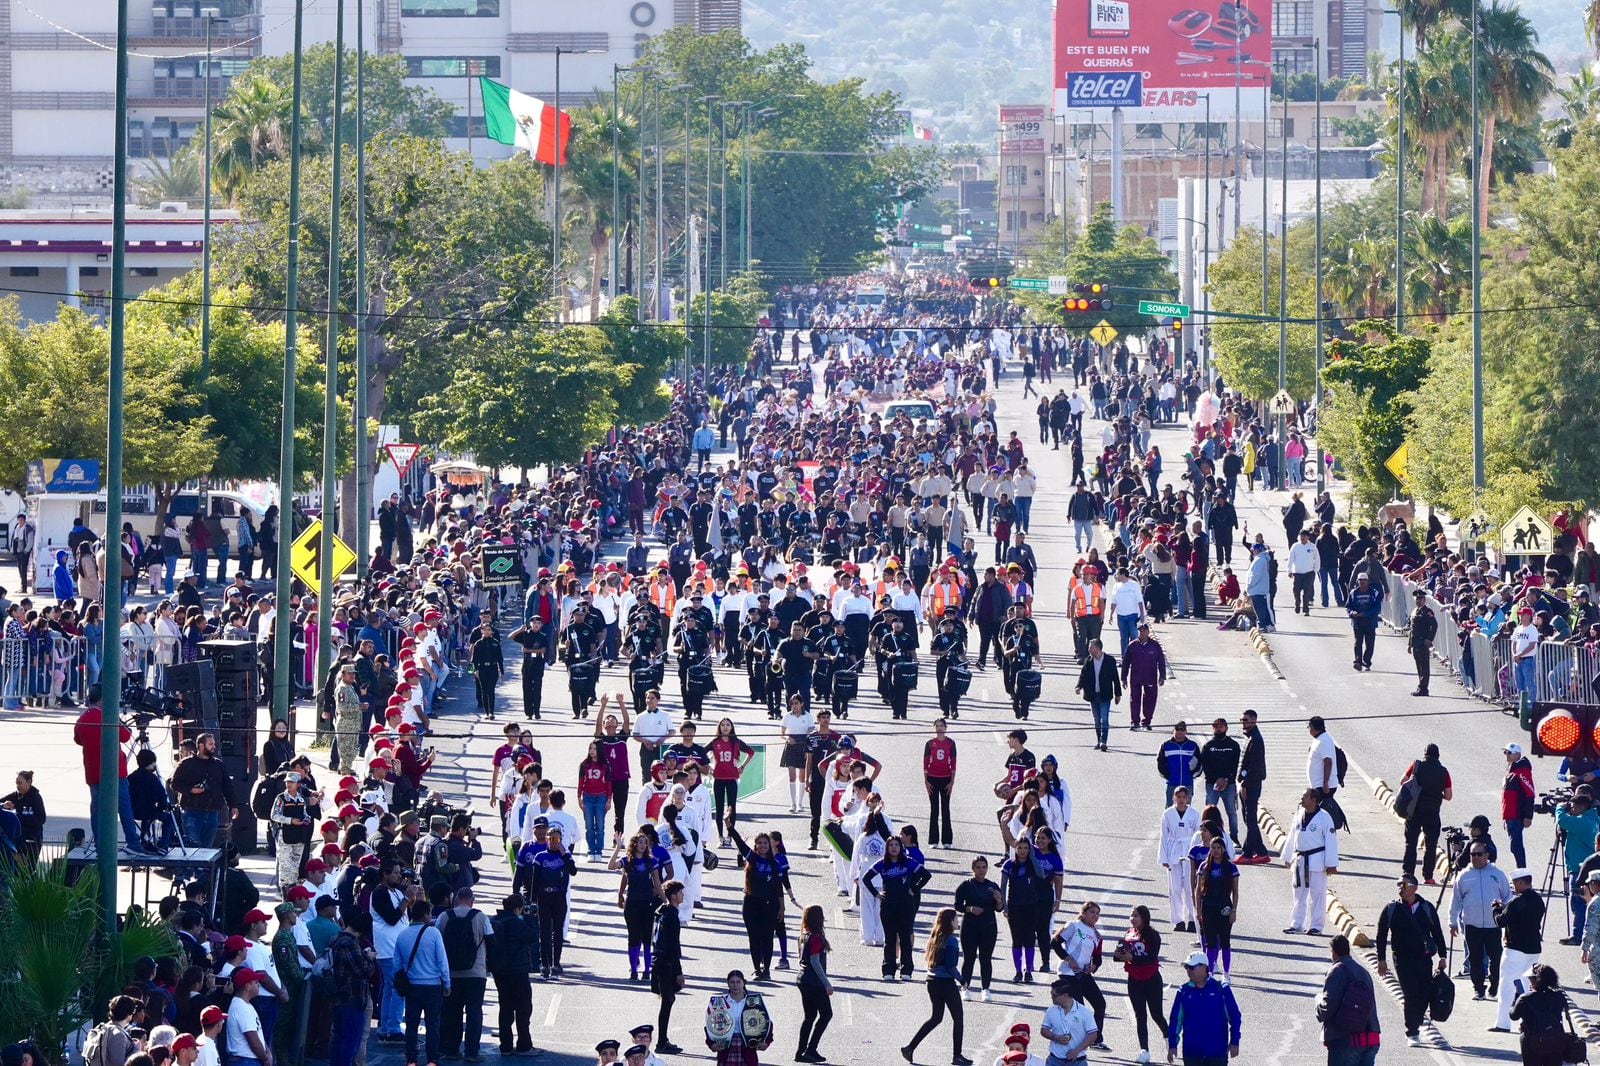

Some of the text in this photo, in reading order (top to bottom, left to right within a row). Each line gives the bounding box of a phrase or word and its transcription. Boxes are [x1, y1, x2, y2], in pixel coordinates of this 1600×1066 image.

[1097, 4, 1123, 14] BUEN
[1067, 46, 1150, 55] ESTE BUEN FIN
[1083, 57, 1134, 67] QUERRÁS
[1072, 74, 1135, 98] telcel
[1146, 304, 1182, 315] SONORA
[610, 748, 616, 759] 4
[936, 750, 945, 761] 6
[587, 769, 601, 780] 13
